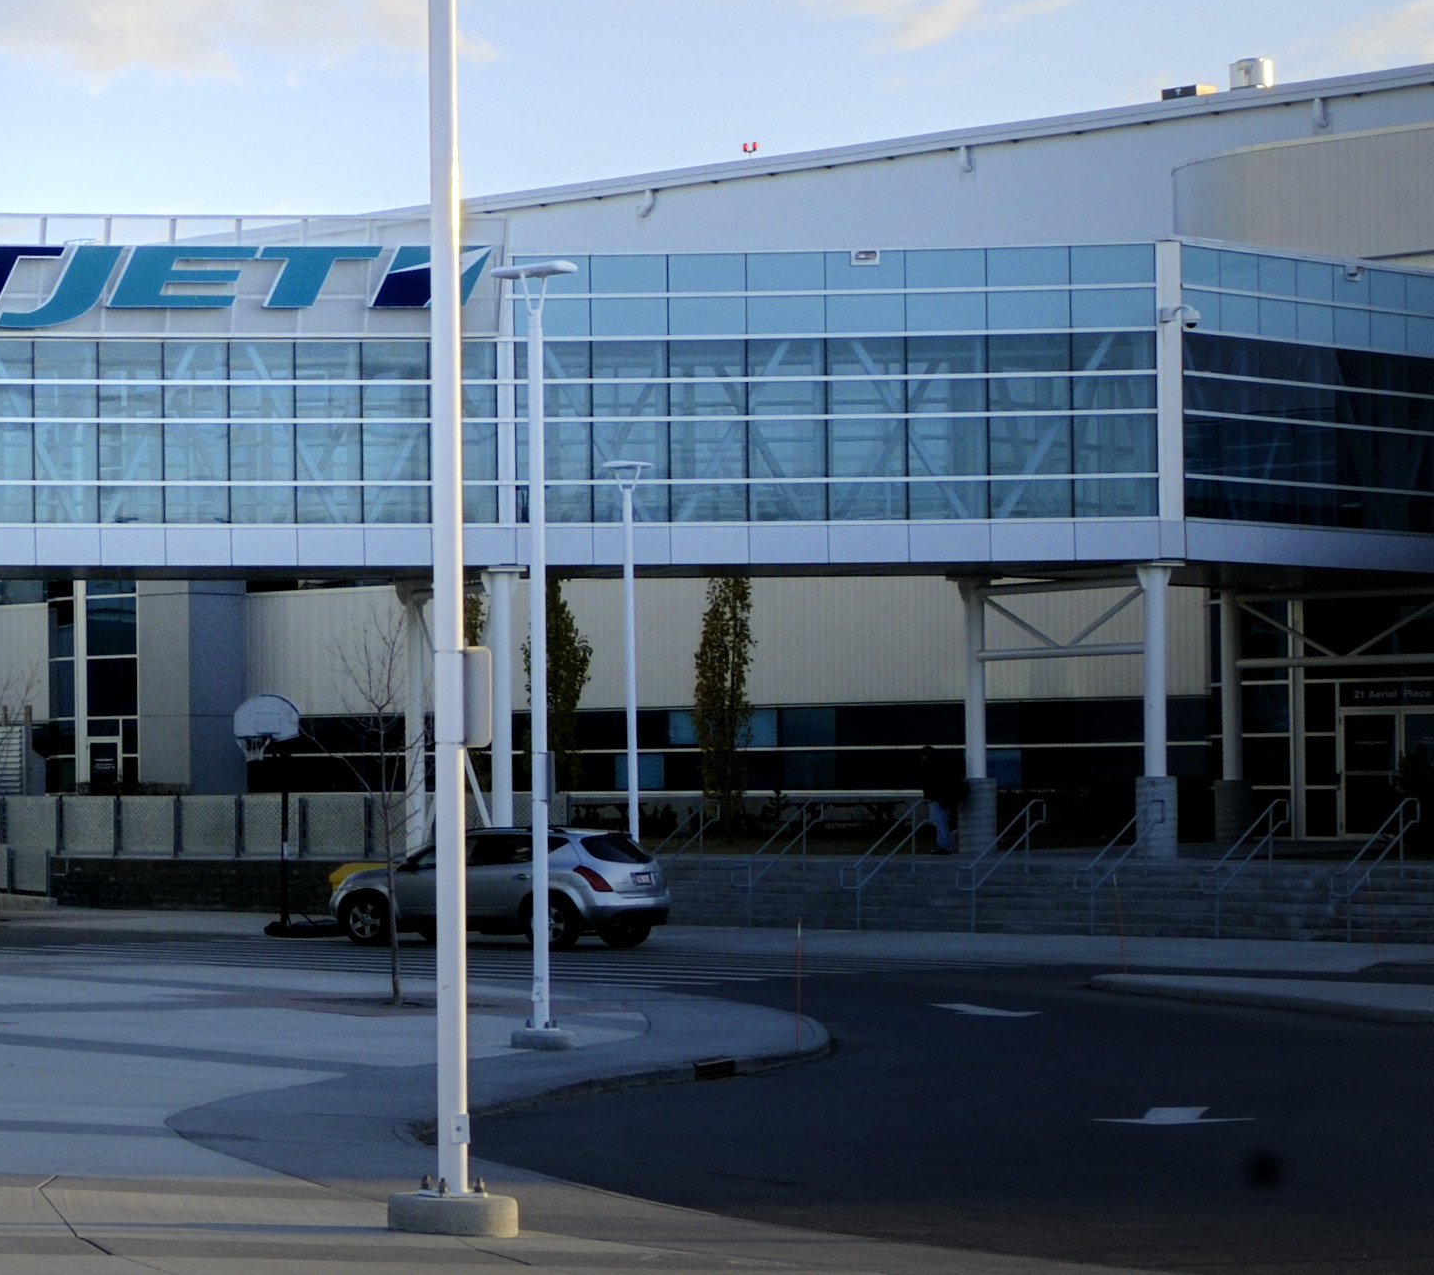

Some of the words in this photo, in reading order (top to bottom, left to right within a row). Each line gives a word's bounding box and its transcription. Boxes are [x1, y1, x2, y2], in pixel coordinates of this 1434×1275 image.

[1353, 690, 1364, 699] 21
[1368, 689, 1398, 699] Aerial
[1403, 688, 1433, 698] Place
